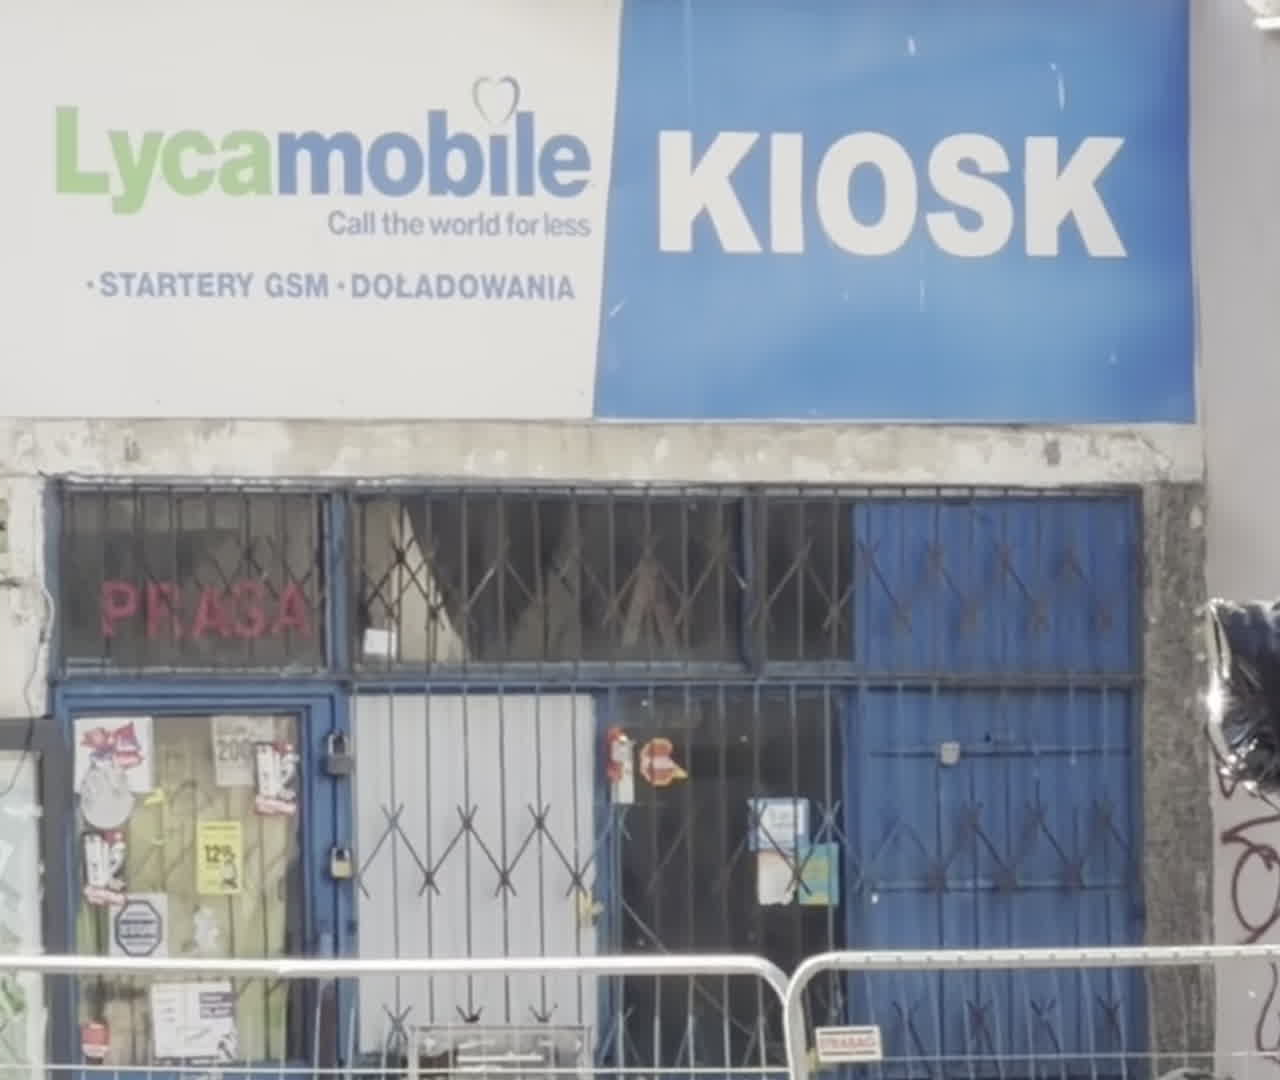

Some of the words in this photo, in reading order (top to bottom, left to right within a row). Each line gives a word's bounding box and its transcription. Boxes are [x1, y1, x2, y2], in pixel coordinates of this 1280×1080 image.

[54, 105, 592, 214] Lycamobile
[658, 130, 1129, 258] KIOSK
[327, 210, 377, 237] Call
[382, 210, 425, 236] the
[428, 210, 501, 237] world
[505, 211, 539, 237] for
[543, 211, 592, 238] less
[99, 271, 254, 299] STARTERY
[265, 272, 329, 299] GSM
[352, 272, 575, 300] DOŁADOWANIA
